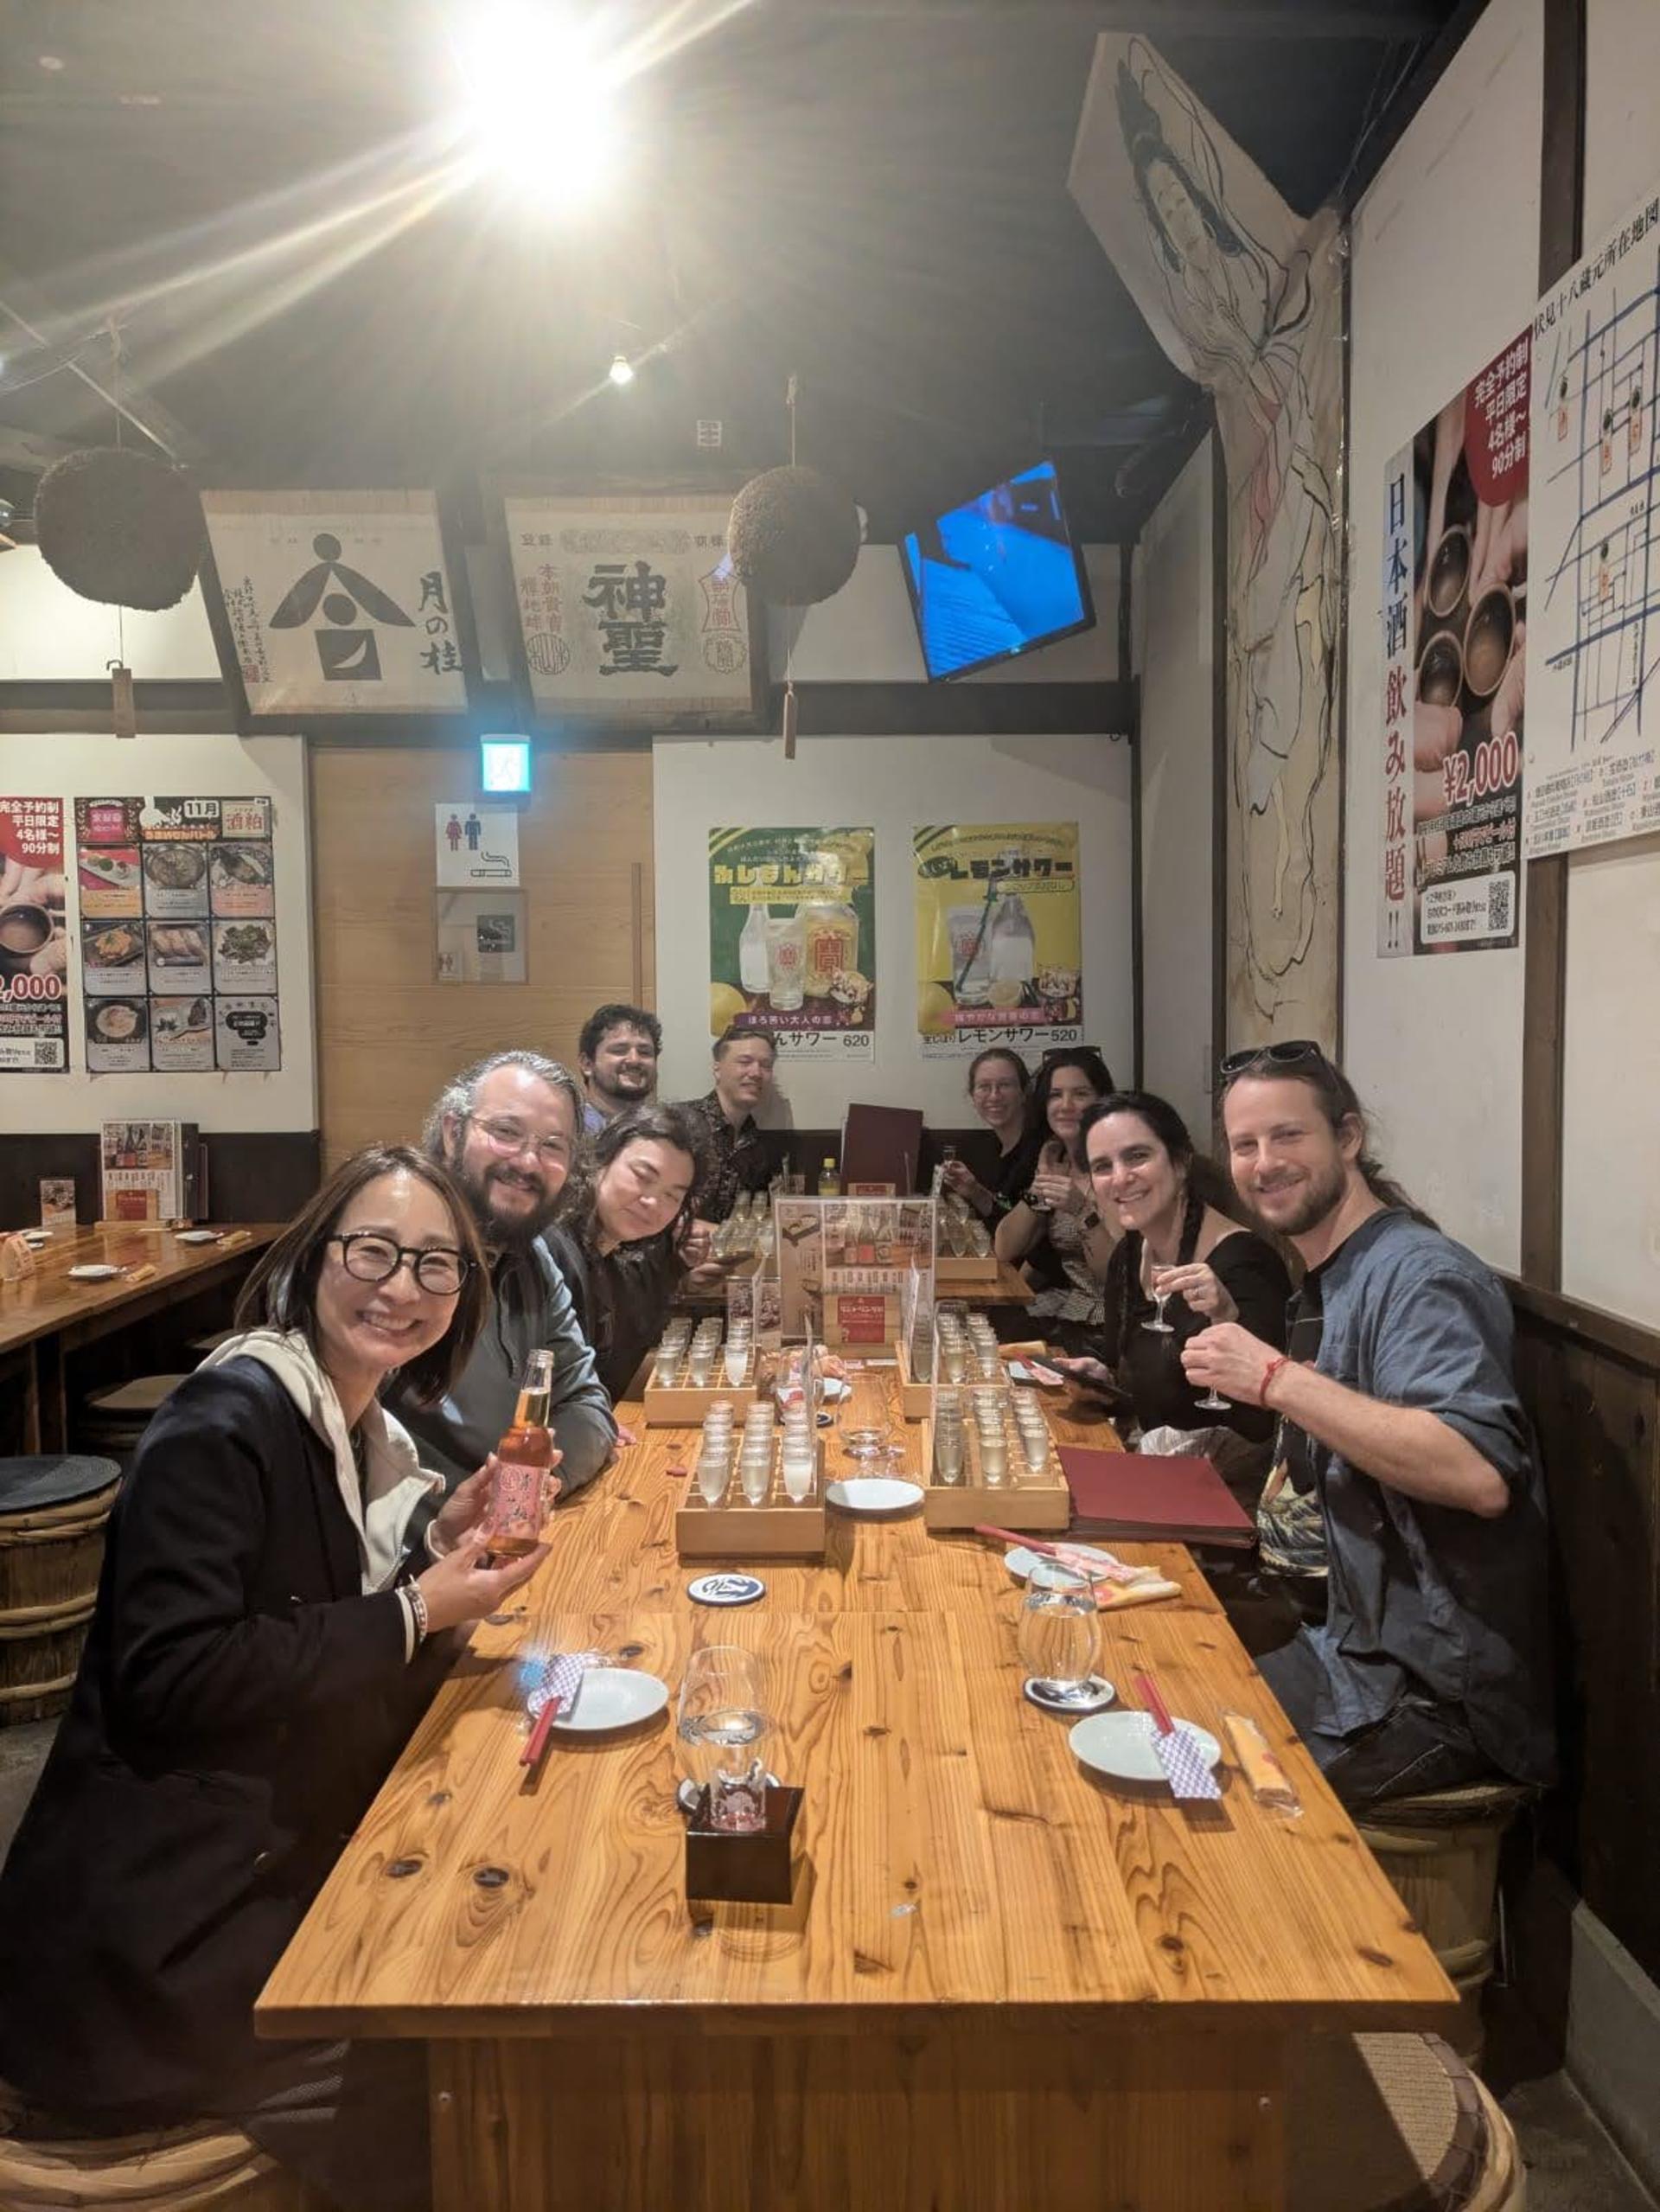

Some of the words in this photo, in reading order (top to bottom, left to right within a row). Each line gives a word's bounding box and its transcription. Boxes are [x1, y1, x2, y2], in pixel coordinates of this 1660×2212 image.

[1474, 336, 1529, 409] 完全予約制
[1485, 372, 1527, 425] 平日限定
[1492, 432, 1526, 479] 90分制
[418, 571, 463, 675] 月の桂
[581, 560, 679, 676] 神聖
[1443, 732, 1518, 808] ¥2,000
[12, 815, 60, 828] 平日限定
[186, 802, 217, 815] 11月
[22, 842, 61, 854] 90分制
[843, 1034, 870, 1047] 620
[958, 1028, 1049, 1044] レモンサワー
[1051, 1030, 1077, 1042] 520
